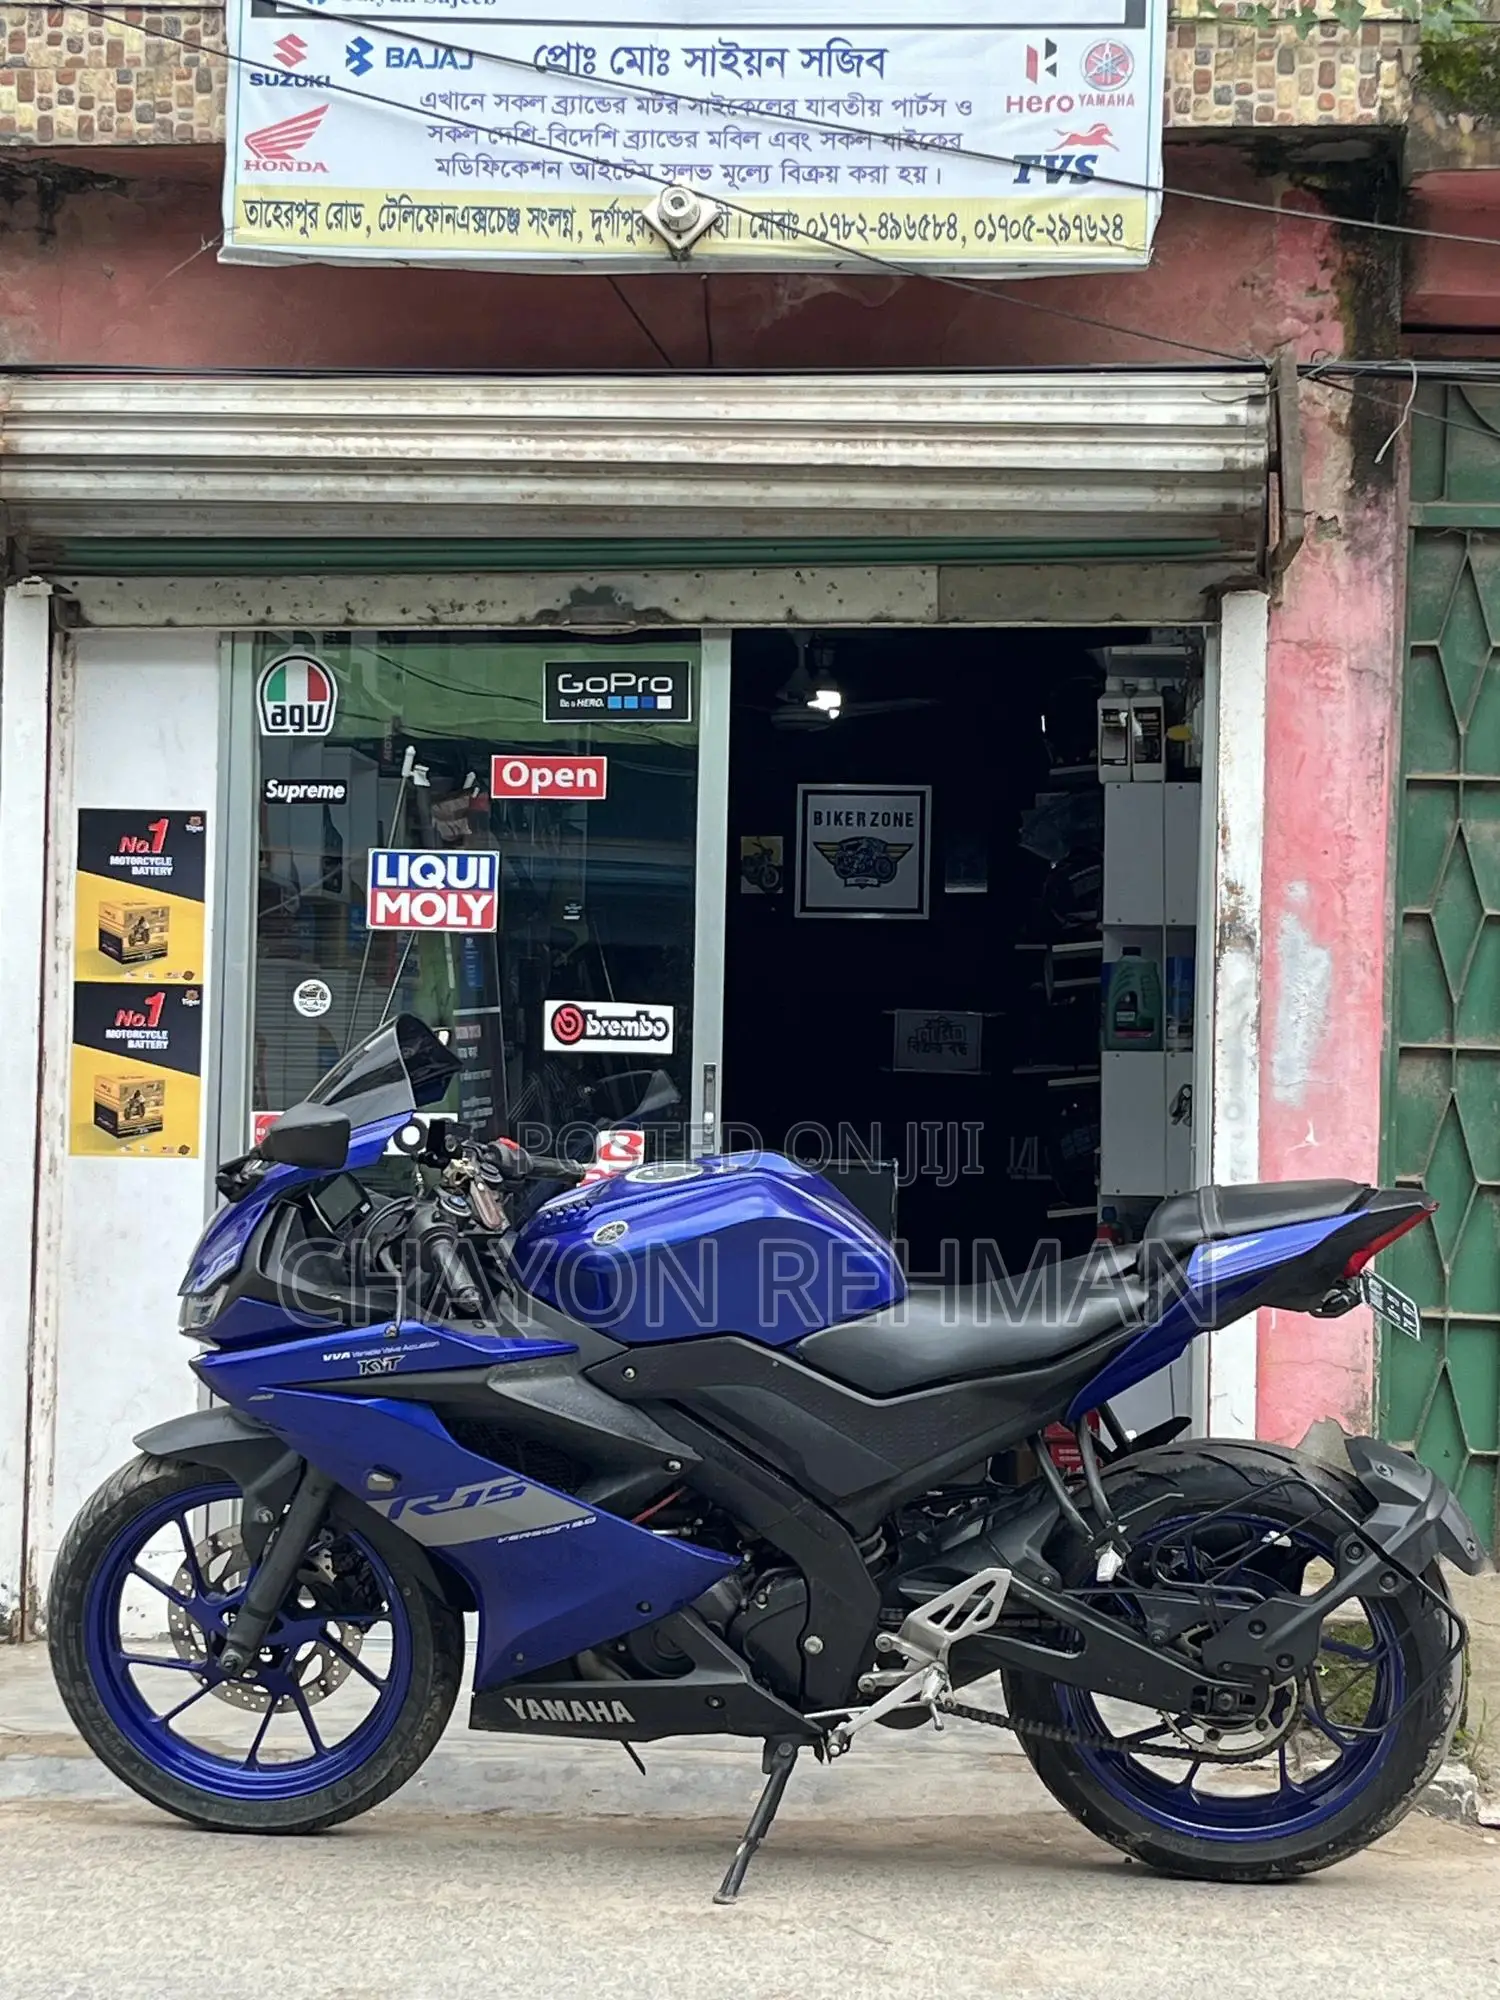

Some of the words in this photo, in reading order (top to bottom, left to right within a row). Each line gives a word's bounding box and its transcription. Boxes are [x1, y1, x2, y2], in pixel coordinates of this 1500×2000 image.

[386, 46, 475, 71] BAJAJ
[611, 44, 670, 76] মোঃ
[681, 37, 790, 79] সাইয়ন
[797, 37, 890, 79] সজিব
[250, 73, 332, 89] SUZUKI
[420, 91, 486, 113] এখানে
[493, 93, 548, 114] সকল
[635, 91, 681, 115] মটর
[688, 92, 798, 117] সাইকেলের
[805, 92, 883, 117] যাবতীয়
[892, 92, 947, 117] পার্টস
[956, 100, 973, 116] ও
[1006, 95, 1074, 113] Hero
[1078, 93, 1135, 107] YAMAHA
[426, 125, 478, 145] সকল
[488, 120, 619, 148] দেশি-বিদেশি
[707, 124, 760, 150] মবিল
[768, 132, 812, 152] এবং
[820, 131, 872, 150] সকল
[244, 160, 330, 173] HONDA
[435, 152, 563, 180] মডিফিকেশন
[569, 156, 652, 181] আইটেম
[720, 164, 773, 189] মূল্যে
[781, 158, 841, 184] বিক্রয়
[848, 164, 890, 184] করা
[1013, 154, 1099, 184] TVS
[242, 198, 321, 238] তাহেরপুর
[974, 212, 1124, 246] ০১৭০৫-২৯৭৬২৪
[558, 673, 673, 693] GoPro
[271, 704, 324, 733] agv
[502, 760, 597, 794] Open
[266, 779, 345, 802] Supreme
[110, 855, 173, 867] MOTORCYCLE
[131, 866, 173, 876] BATTERY
[377, 854, 490, 890] LIQUI
[375, 891, 493, 926] MOLY
[105, 1029, 169, 1040] MOTORCYCLE
[584, 1010, 669, 1041] brembo
[127, 1039, 169, 1050] BATTERY
[322, 1351, 351, 1362] VVA
[357, 1355, 406, 1375] KYT
[504, 1697, 636, 1723] YAMAHA
